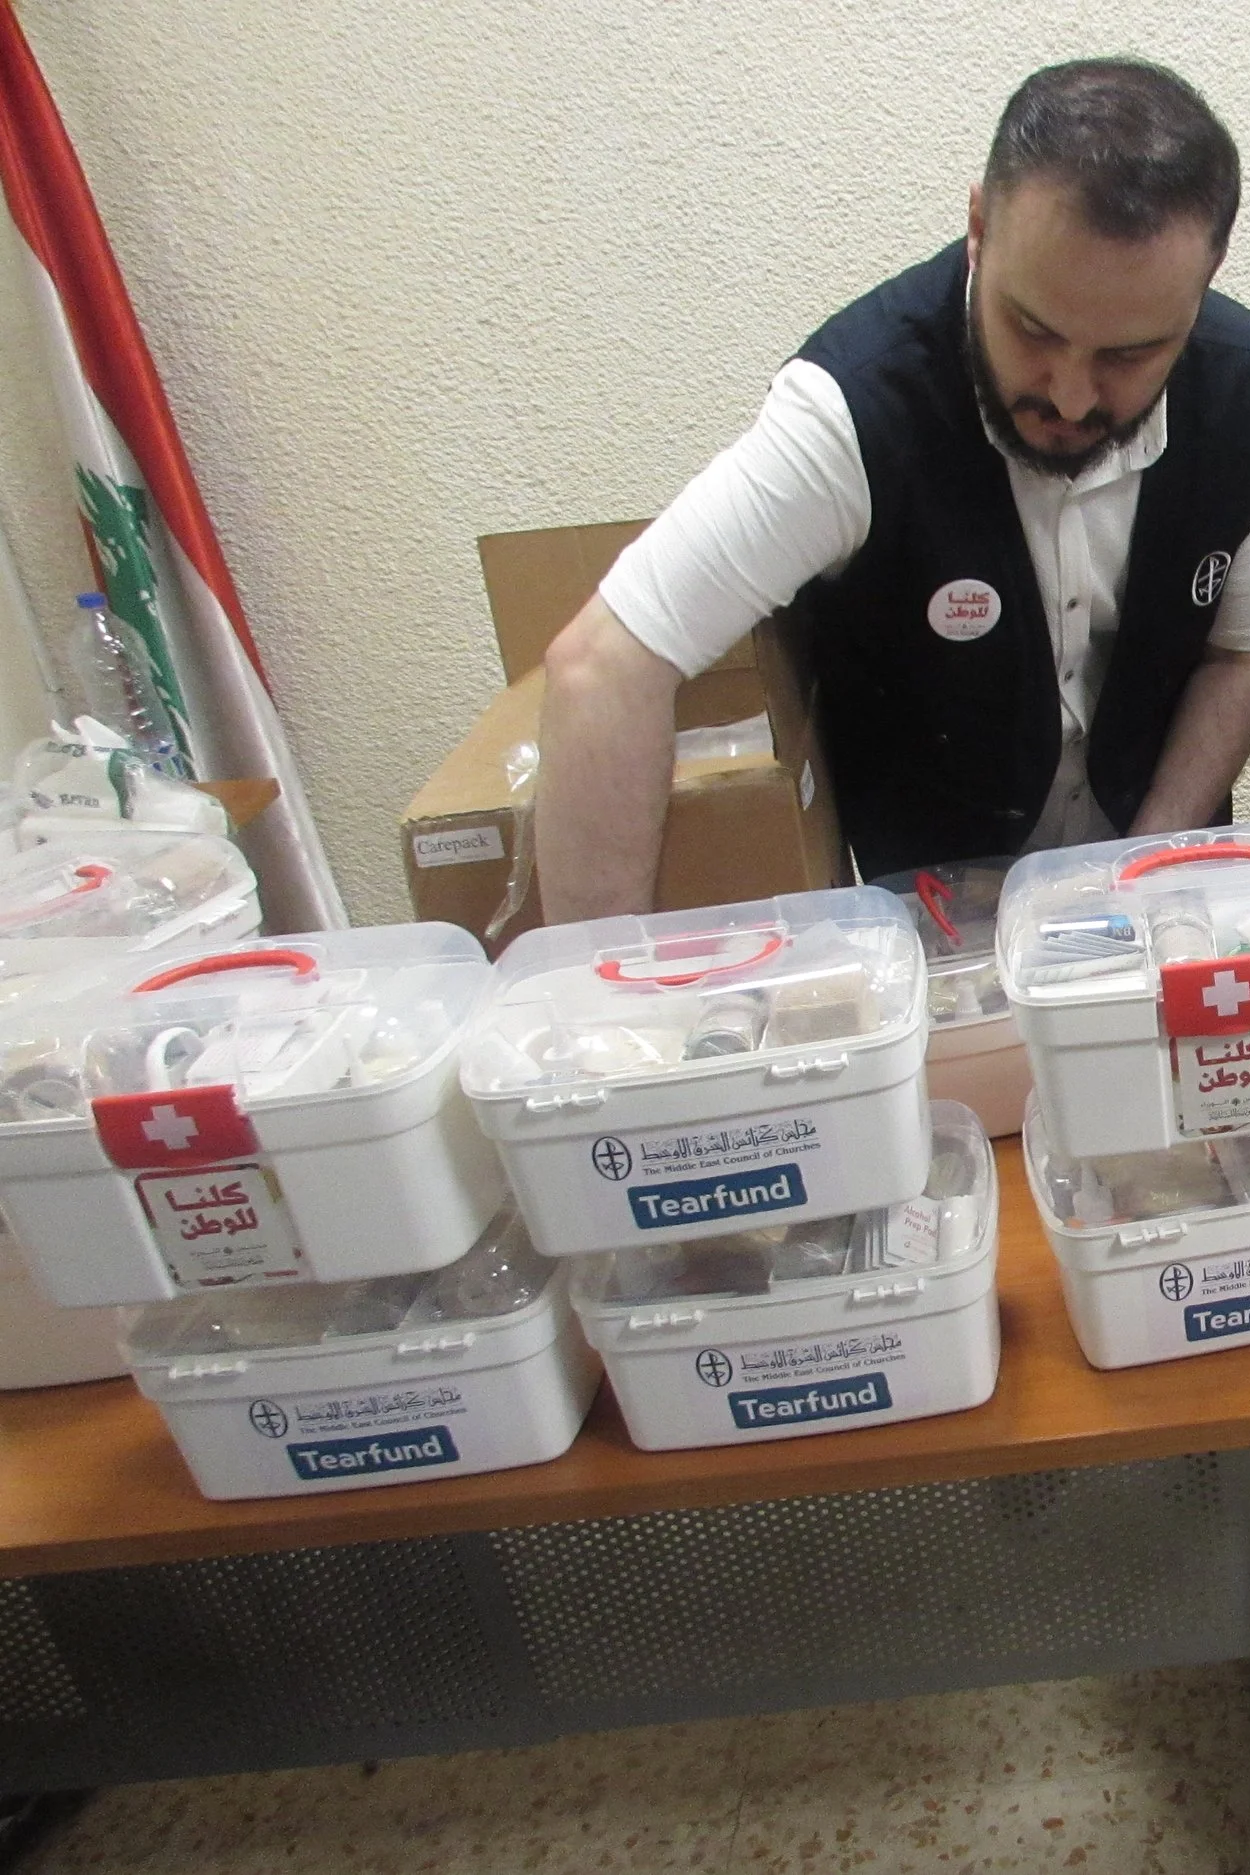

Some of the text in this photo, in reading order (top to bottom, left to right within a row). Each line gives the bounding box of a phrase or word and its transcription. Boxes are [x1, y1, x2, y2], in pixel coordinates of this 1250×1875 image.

[947, 590, 990, 604] كلنا
[945, 605, 989, 620] للوطن
[417, 832, 490, 854] Carepack
[781, 1119, 816, 1141] مجلس
[644, 1142, 821, 1176] The Middle East Council of Churches
[165, 1181, 249, 1212] كلنا
[639, 1174, 791, 1219] Tearfund
[181, 1206, 259, 1240] للوطن
[1219, 1282, 1246, 1292] Middle
[743, 1353, 906, 1383] The Middle East Council of Churches
[738, 1382, 878, 1420] Tearfund
[299, 1435, 443, 1471] Tearfund
